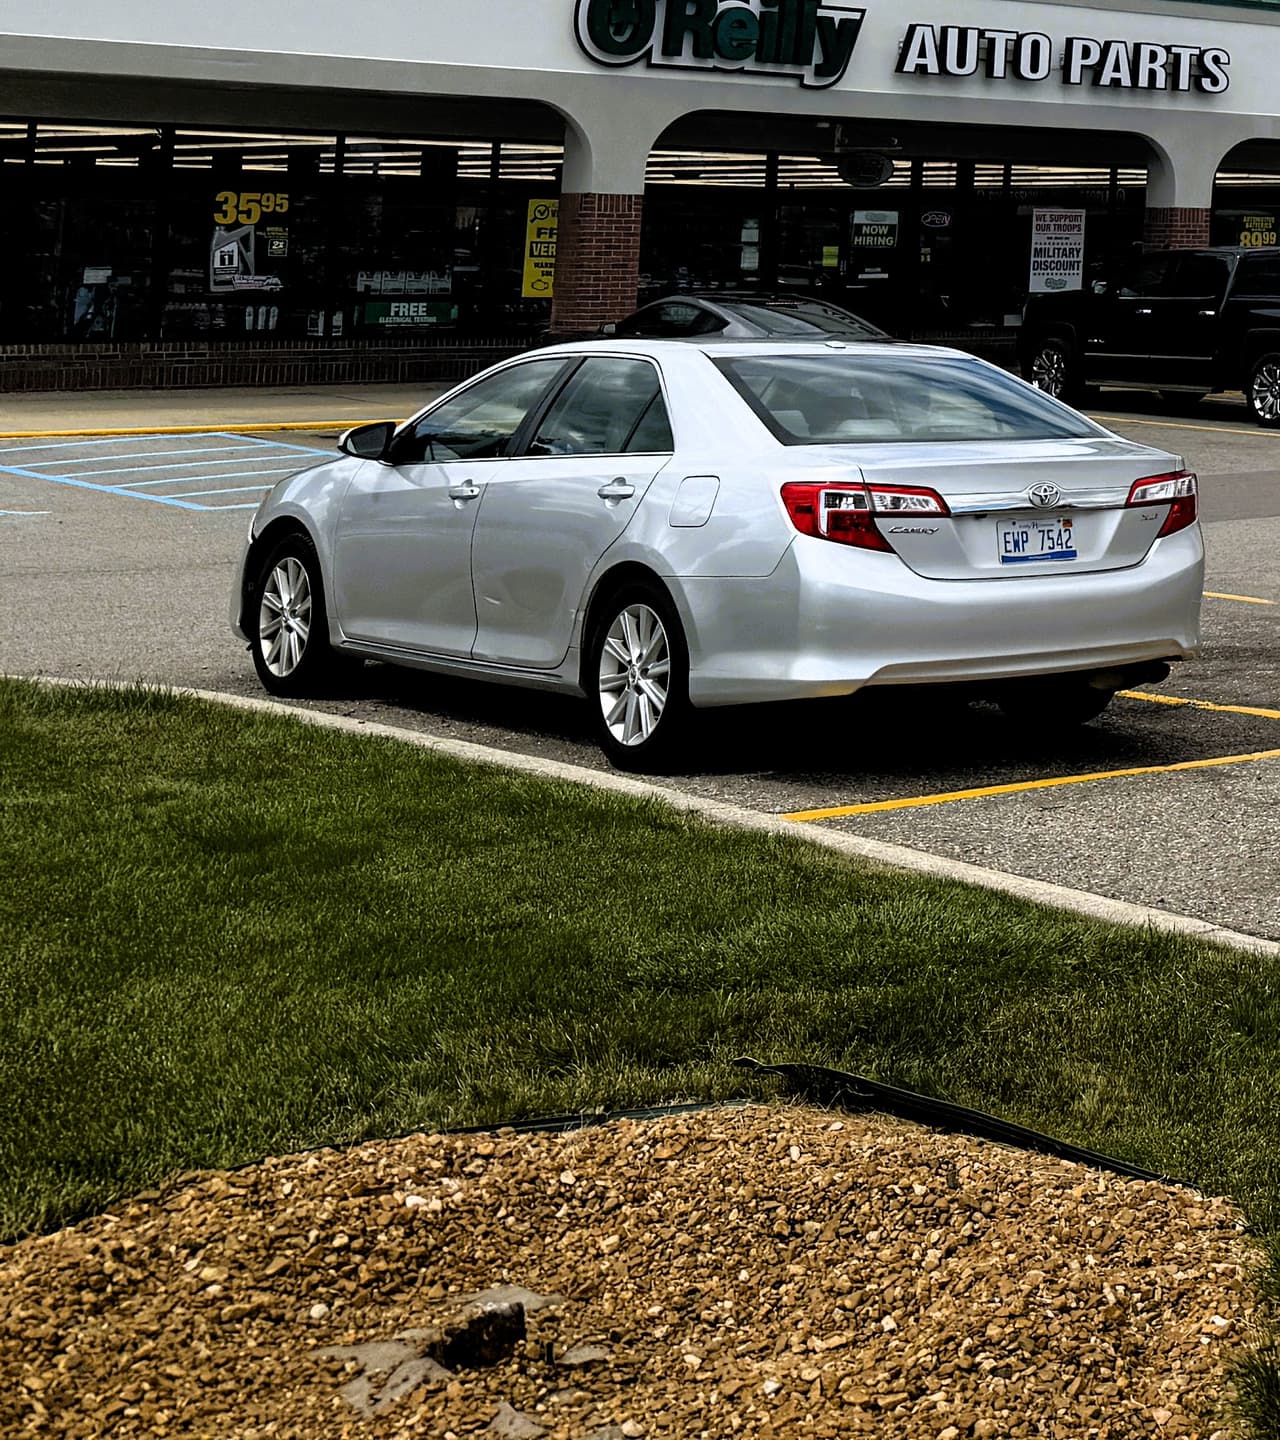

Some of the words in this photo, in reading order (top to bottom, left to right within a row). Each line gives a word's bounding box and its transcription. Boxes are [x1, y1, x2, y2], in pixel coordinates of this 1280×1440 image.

[896, 24, 1052, 82] AUTO
[1062, 36, 1232, 95] PARTS
[922, 212, 951, 225] OPEN
[1035, 214, 1047, 222] WE
[1050, 214, 1083, 223] SUPPORT
[862, 225, 889, 235] NOW
[1035, 223, 1051, 232] OUR
[1053, 224, 1082, 233] TROOPS
[854, 236, 894, 246] HIRING
[1034, 247, 1082, 259] MILITARY
[1032, 260, 1081, 271] DISCOUNT
[390, 302, 427, 316] FREE
[1003, 529, 1029, 553] EWP
[1037, 527, 1073, 551] 7542
